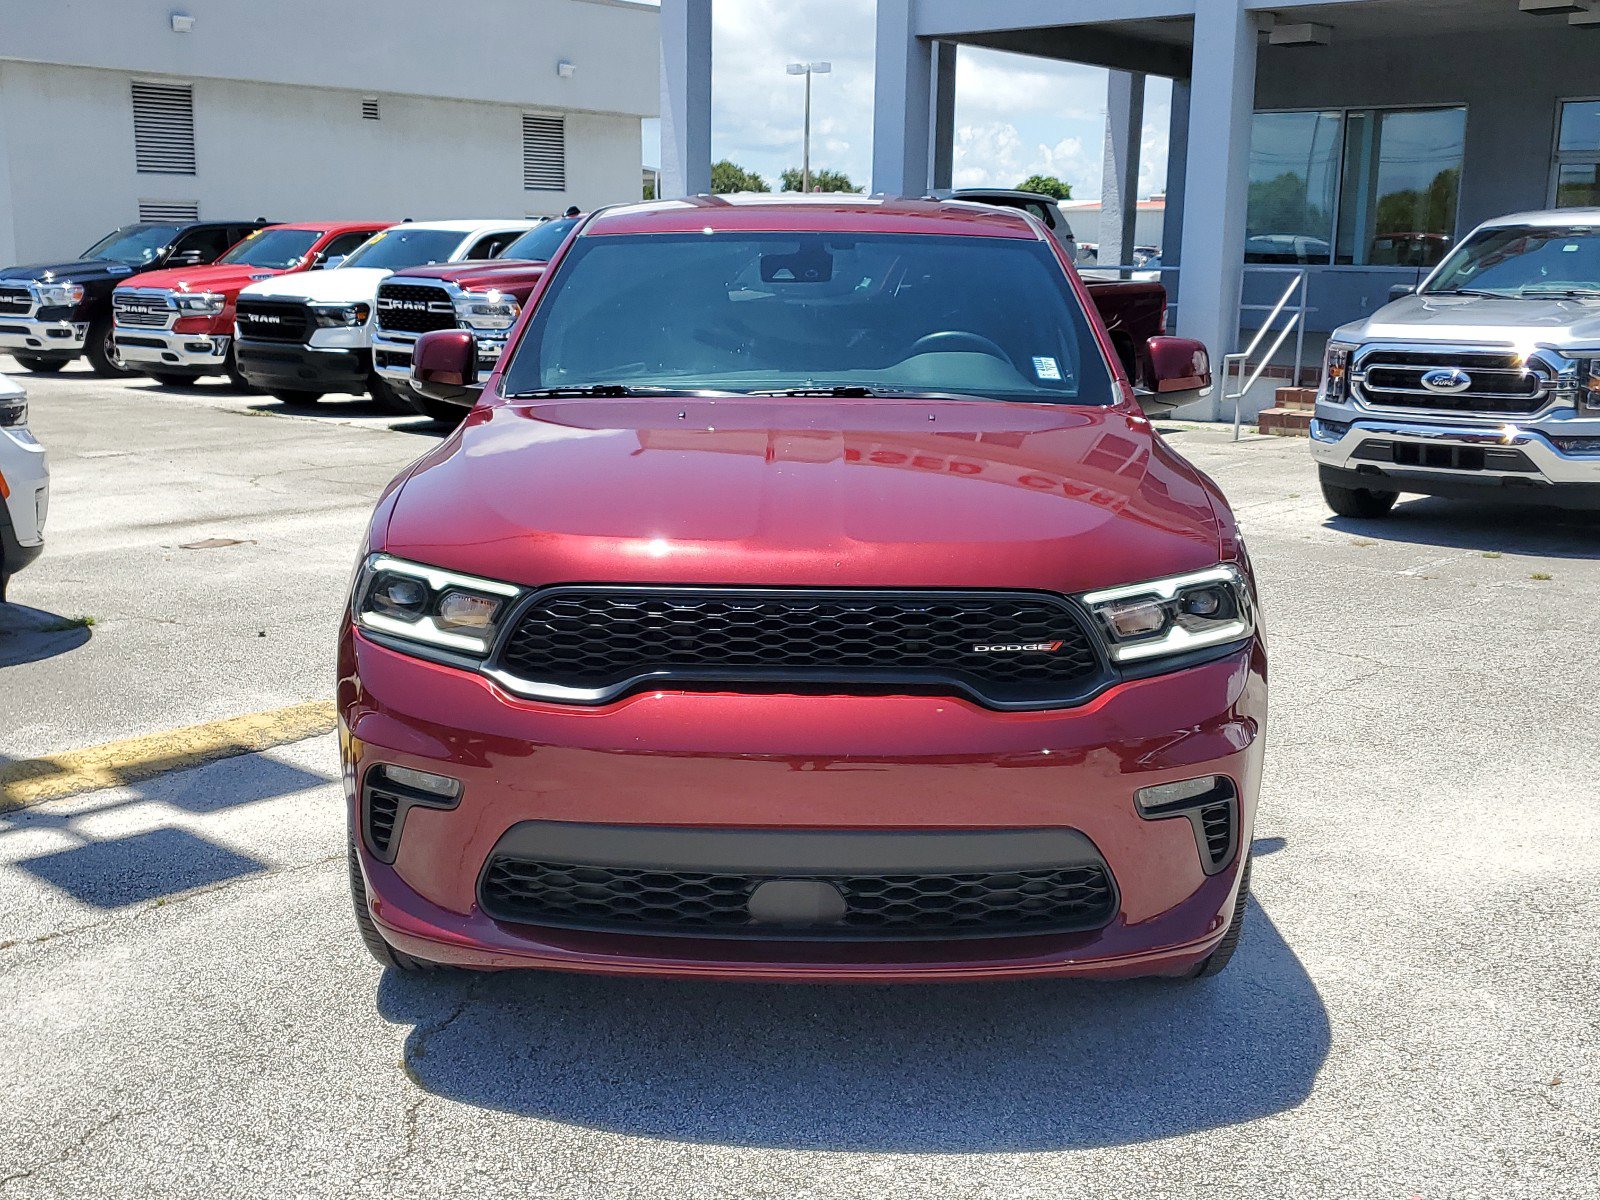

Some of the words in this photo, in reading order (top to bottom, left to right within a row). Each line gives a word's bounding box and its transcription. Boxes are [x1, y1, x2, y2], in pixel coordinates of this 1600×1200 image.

[392, 299, 426, 311] RAM
[247, 313, 280, 324] RAM
[1432, 375, 1456, 387] Ford
[974, 643, 1053, 652] DODGE
